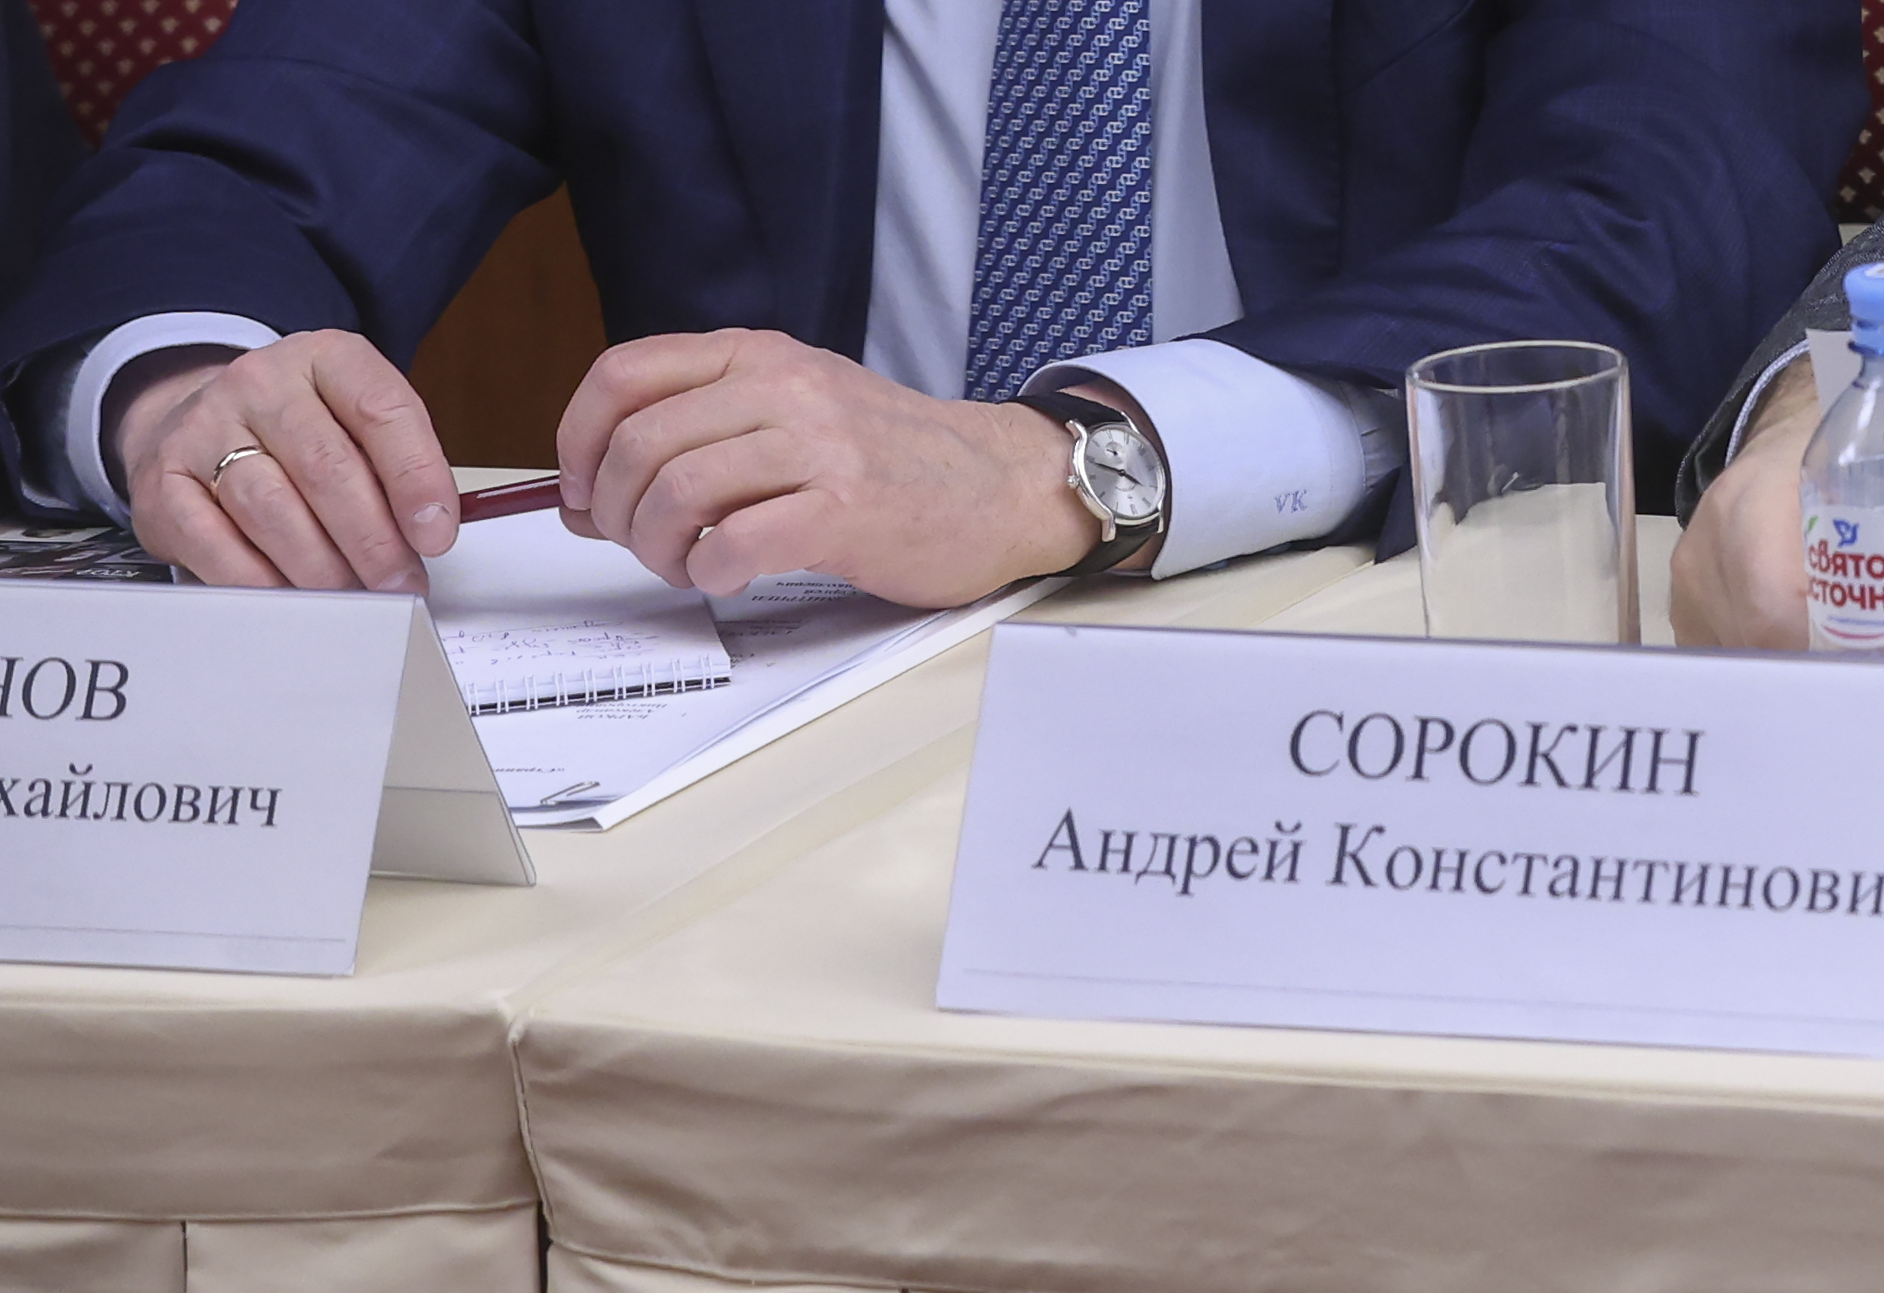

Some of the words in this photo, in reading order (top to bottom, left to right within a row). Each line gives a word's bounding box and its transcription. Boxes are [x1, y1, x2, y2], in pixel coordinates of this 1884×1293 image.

[0, 657, 130, 722] ОВ
[1290, 710, 1706, 797] СОРОКИН
[1033, 809, 1304, 898] Андрей
